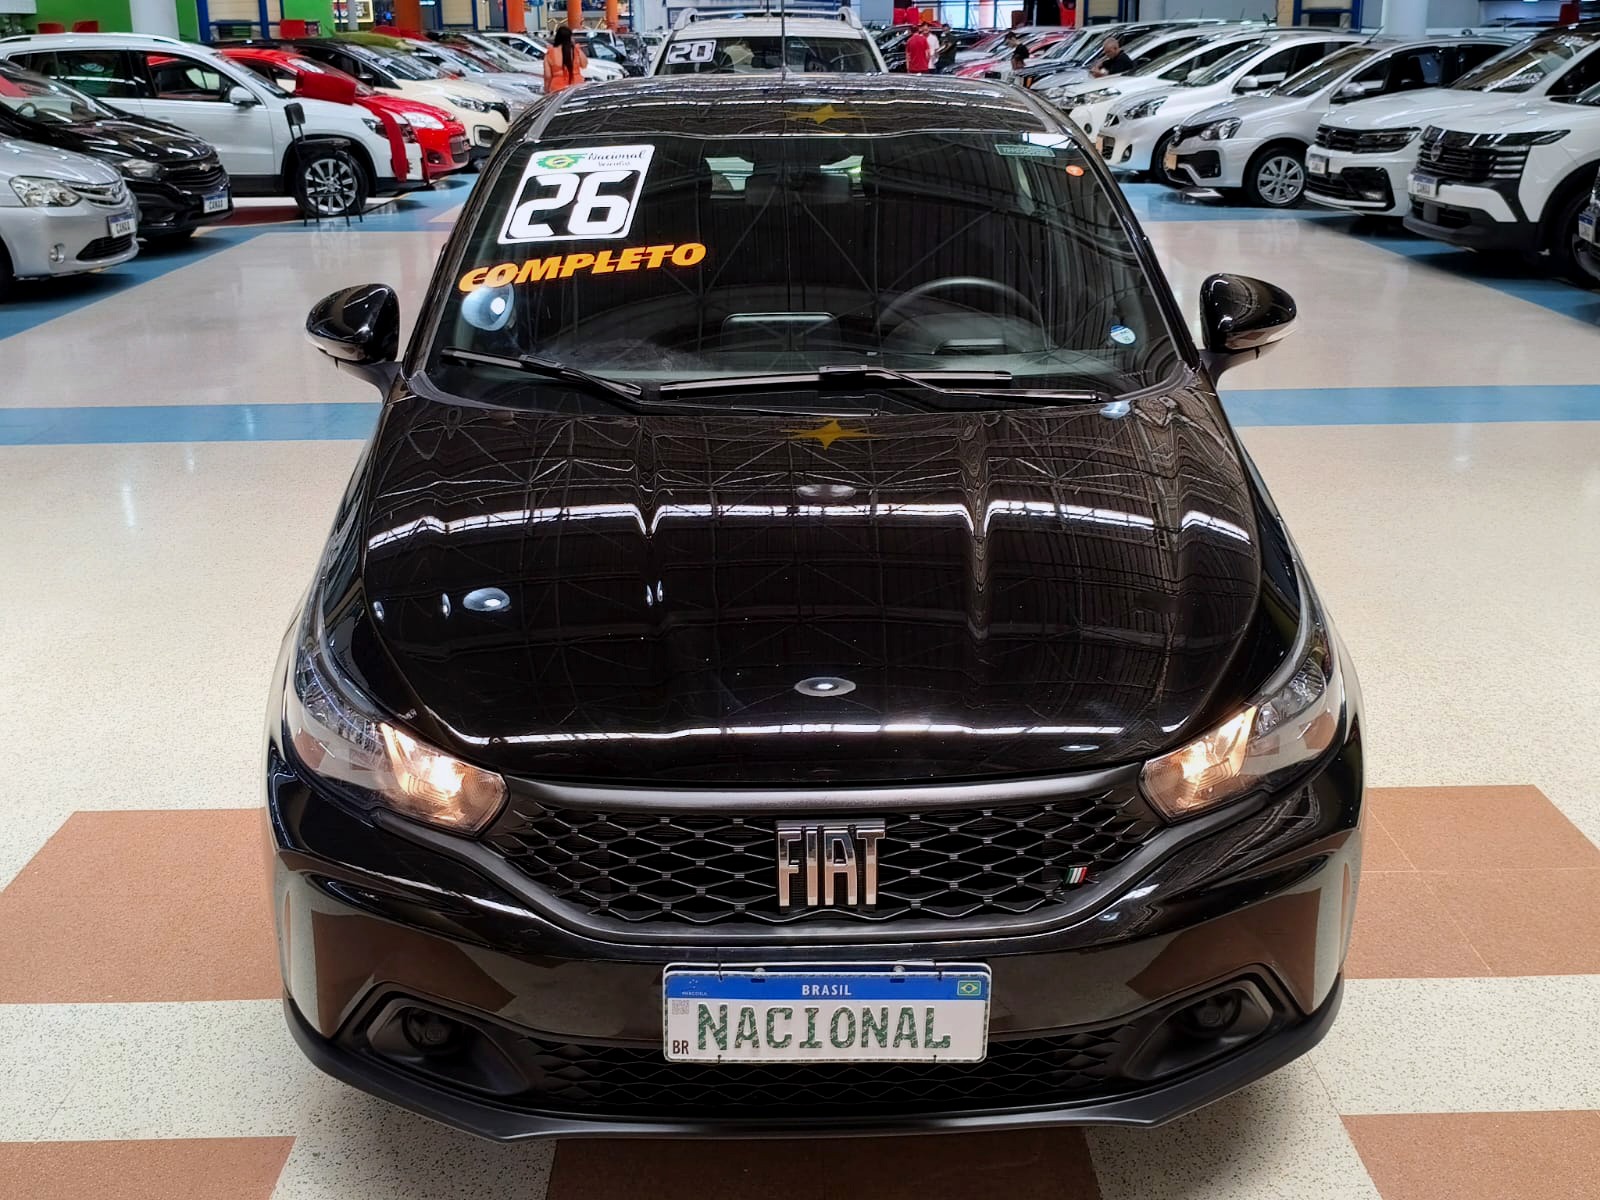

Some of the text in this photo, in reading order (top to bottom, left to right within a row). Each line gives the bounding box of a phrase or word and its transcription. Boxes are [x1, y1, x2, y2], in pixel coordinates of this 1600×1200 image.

[669, 43, 712, 62] 20
[509, 170, 634, 238] 26
[458, 243, 706, 292] COMPLETO
[777, 820, 886, 906] FIAT
[801, 984, 852, 996] BRASIL
[672, 1039, 689, 1054] BR
[698, 1003, 951, 1050] NACIONAL
